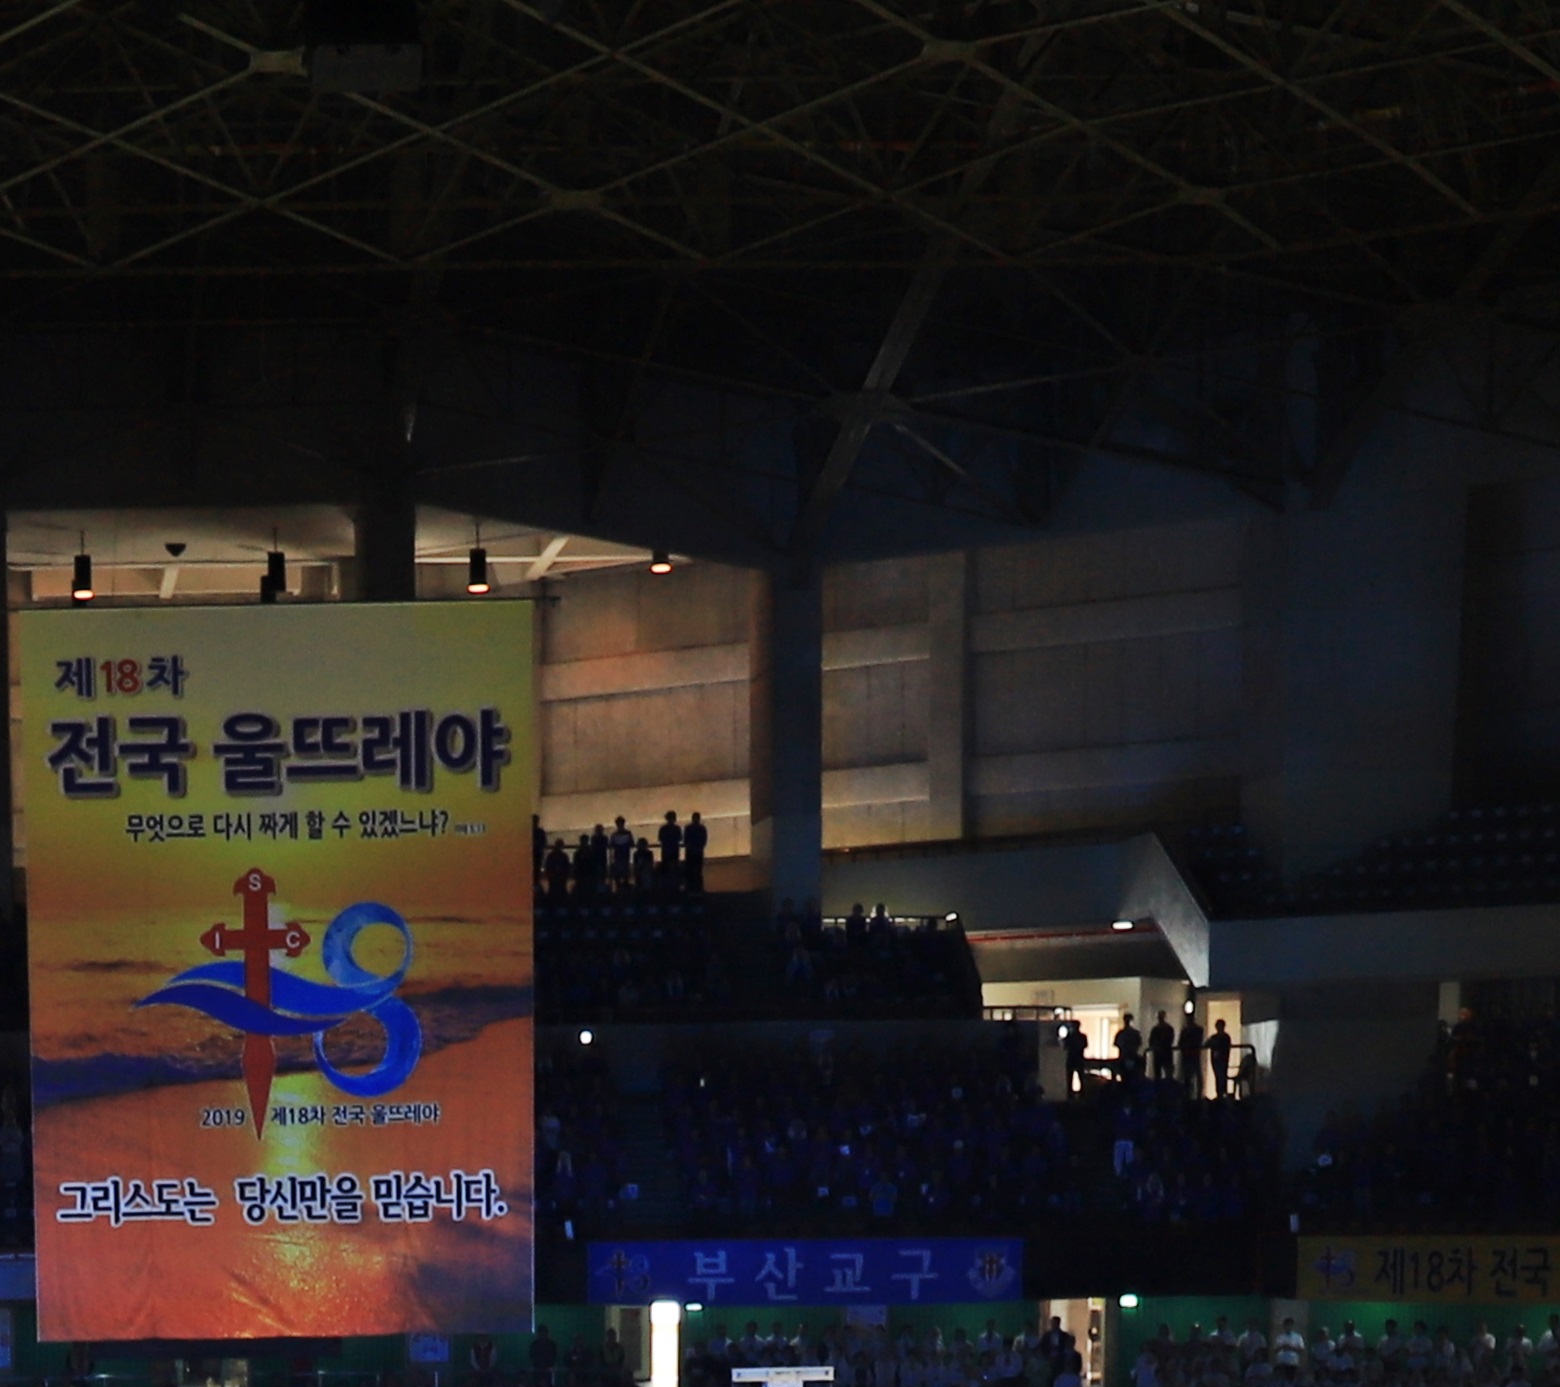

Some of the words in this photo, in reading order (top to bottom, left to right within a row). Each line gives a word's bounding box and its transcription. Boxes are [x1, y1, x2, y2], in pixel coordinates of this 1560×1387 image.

[54, 656, 186, 698] 제18차
[47, 714, 194, 798] 전국
[212, 706, 511, 795] 울뜨레야
[126, 814, 206, 842] 무엇으로
[213, 812, 253, 841] 다시
[259, 811, 299, 841] 짜게
[306, 810, 325, 839] 할
[331, 813, 352, 836] 수
[358, 810, 449, 839] 있겠느냐?
[248, 873, 262, 892] S
[285, 931, 301, 949] C
[201, 1109, 245, 1127] 2019
[271, 1107, 326, 1127] 제18차
[333, 1105, 367, 1126] 전국
[371, 1103, 441, 1126] 울뜨레야
[59, 1179, 217, 1225] 그리스도는
[238, 1174, 363, 1221] 당신만을
[373, 1173, 508, 1220] 믿습니다.
[686, 1247, 940, 1301] 부산교구
[1379, 1247, 1480, 1296] 제18차
[1491, 1247, 1552, 1298] 전국
